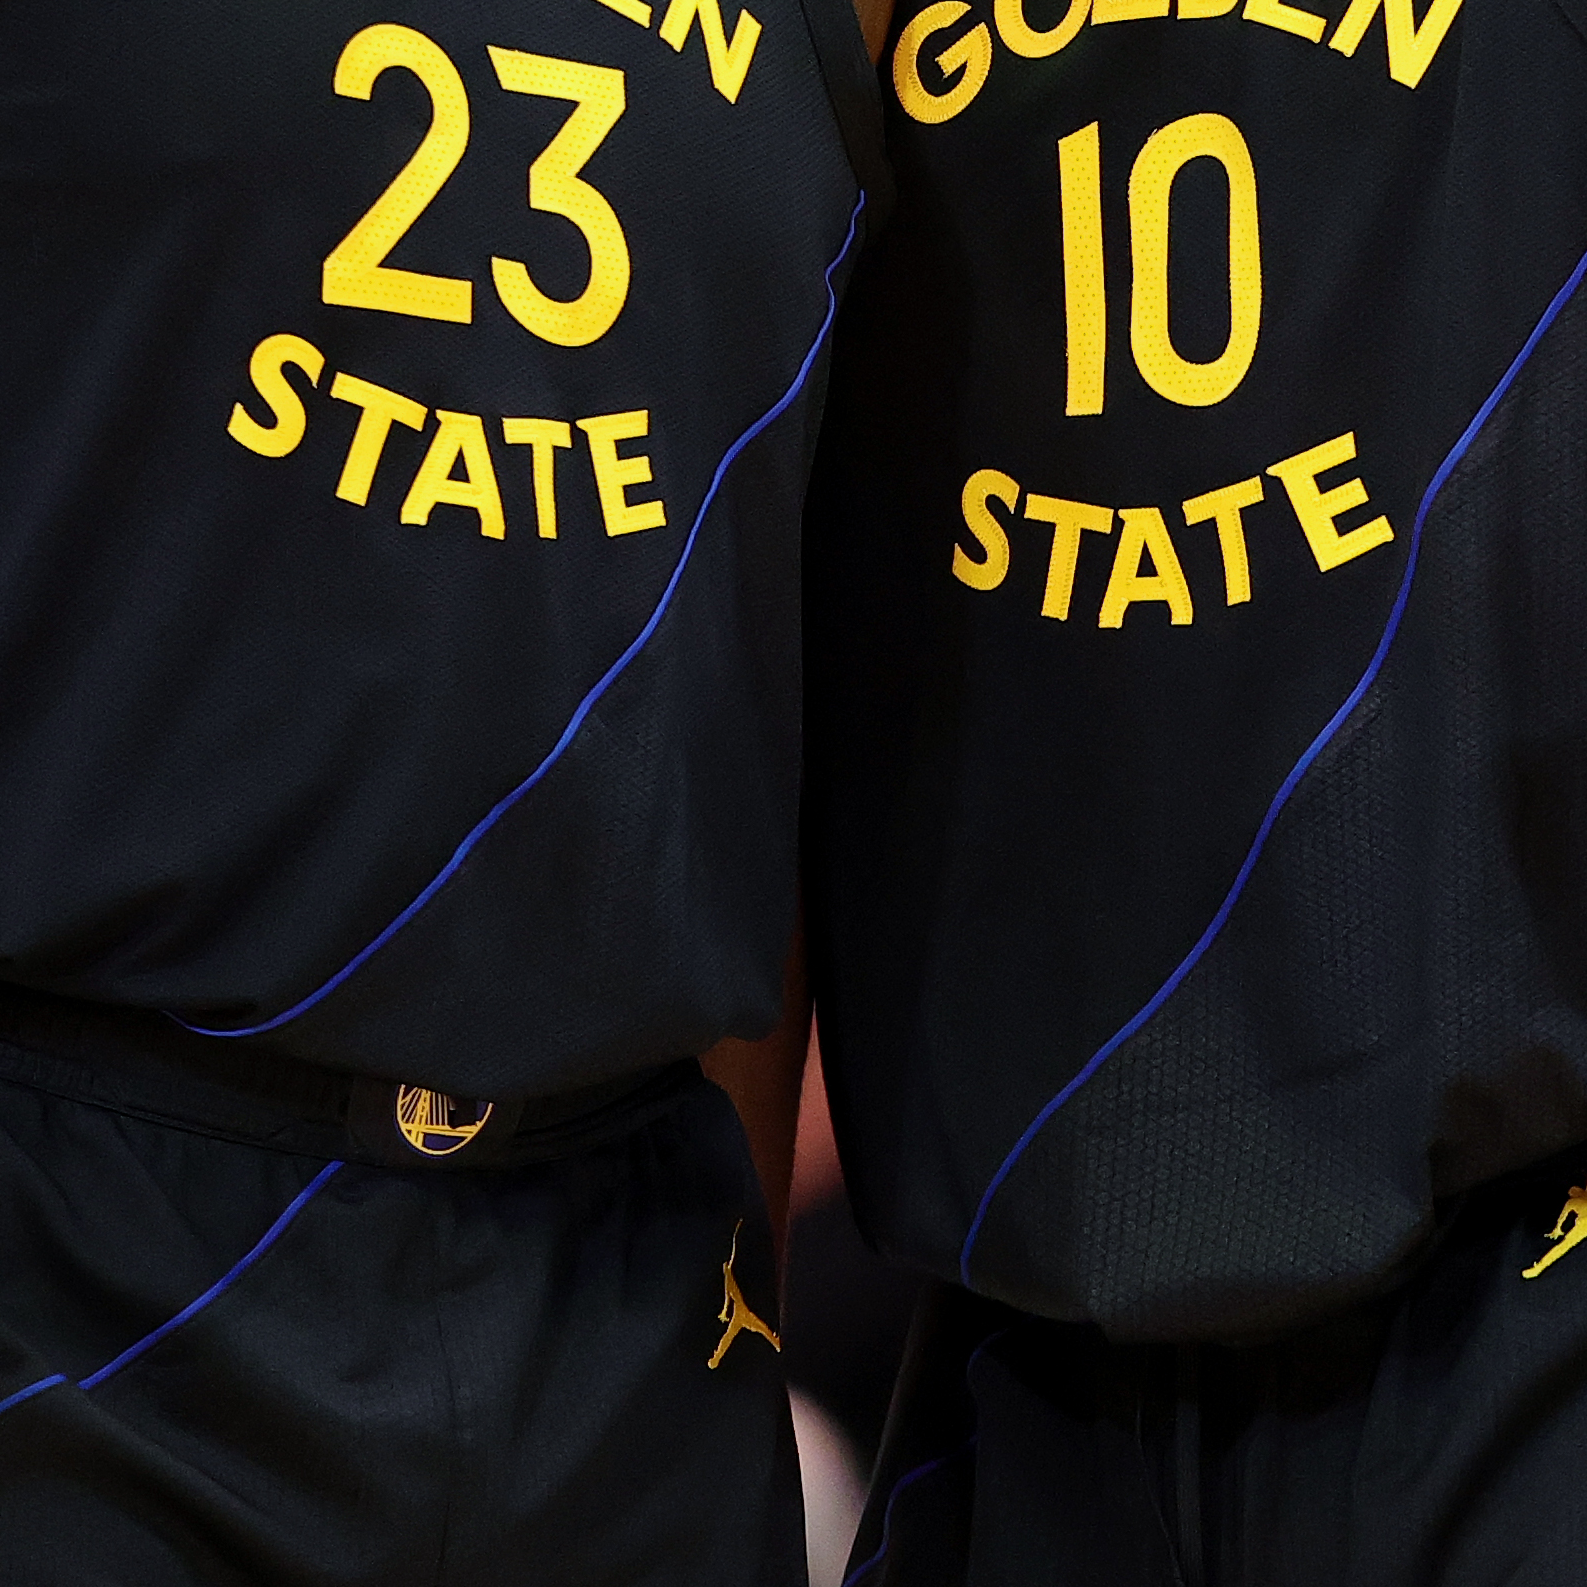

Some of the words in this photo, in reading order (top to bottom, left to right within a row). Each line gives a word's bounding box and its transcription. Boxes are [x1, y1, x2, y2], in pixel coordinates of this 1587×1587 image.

[321, 23, 631, 347] 23
[1057, 112, 1263, 417] 10
[226, 333, 667, 541] STATE
[952, 431, 1395, 630] STATE
